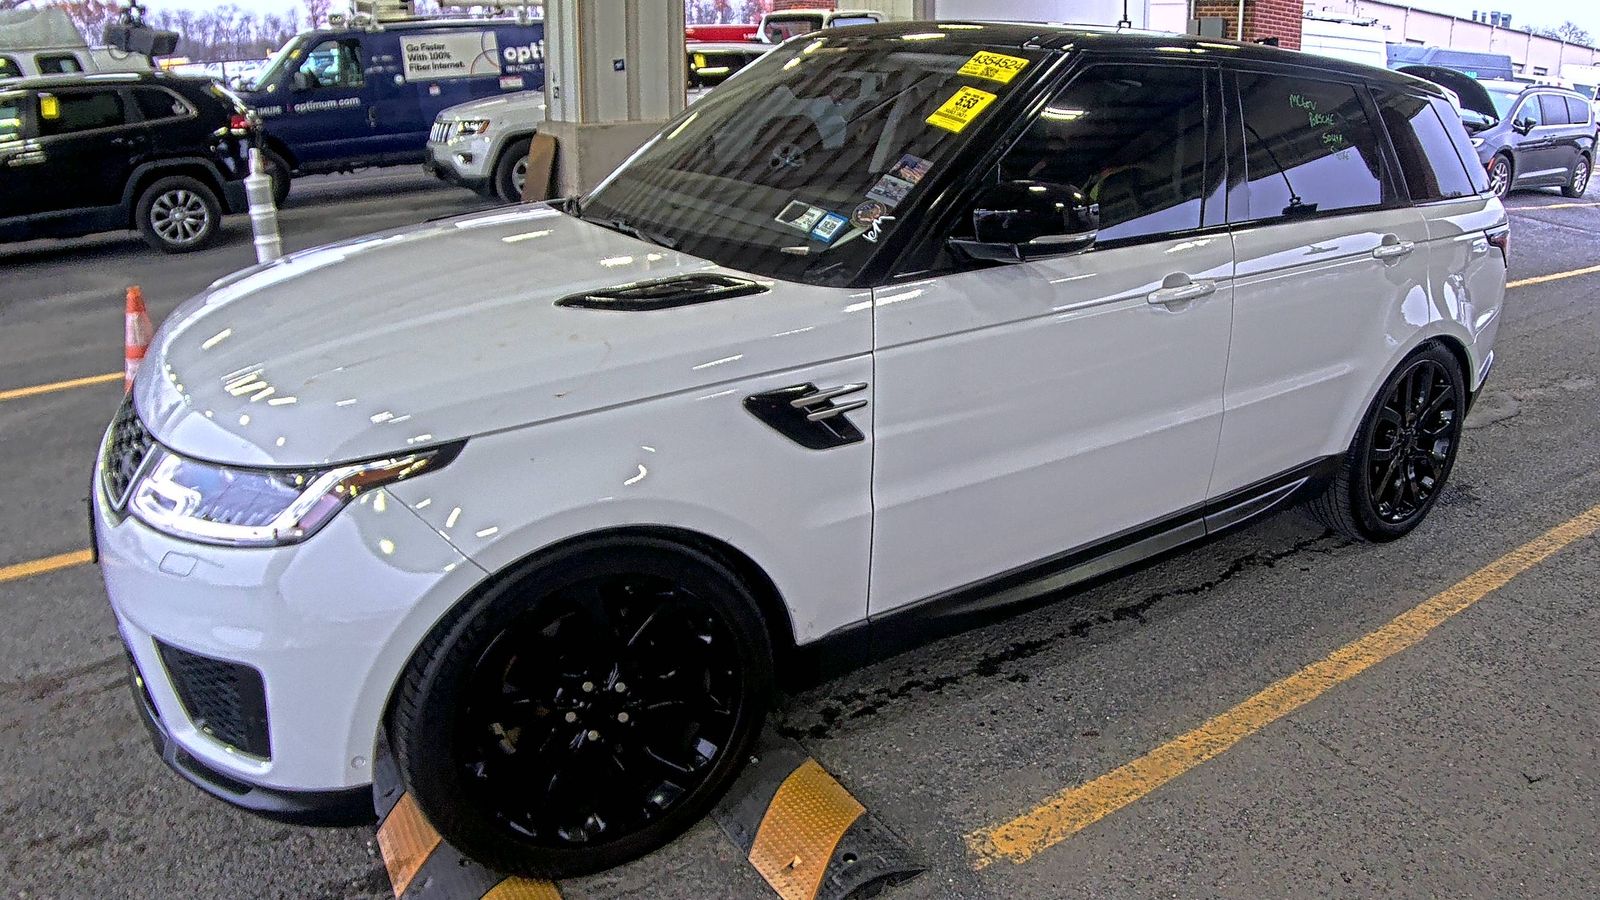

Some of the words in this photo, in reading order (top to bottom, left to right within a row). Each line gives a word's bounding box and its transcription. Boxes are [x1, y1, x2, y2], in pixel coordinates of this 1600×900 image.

[406, 44, 419, 53] Go
[408, 54, 427, 62] With
[430, 52, 451, 60] 100%
[973, 55, 1024, 70] 4354524
[409, 63, 425, 72] Fiber
[427, 61, 465, 70] Internet.
[294, 97, 361, 112] optimum.com
